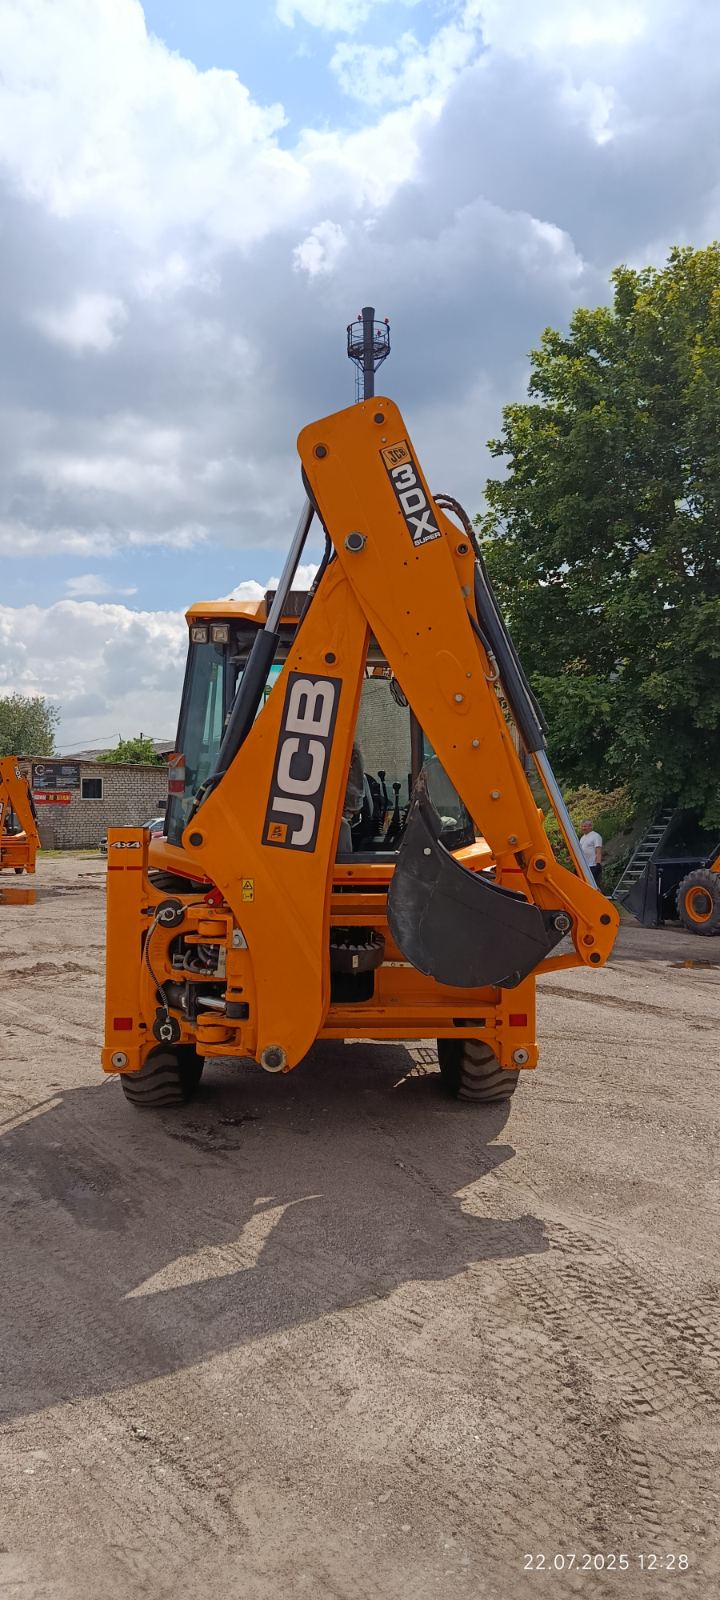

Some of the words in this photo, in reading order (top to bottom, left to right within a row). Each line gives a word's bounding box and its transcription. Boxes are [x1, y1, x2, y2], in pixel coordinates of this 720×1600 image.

[388, 448, 406, 463] JCB
[391, 463, 438, 540] 3DX
[414, 531, 441, 546] SUPER
[272, 679, 335, 846] JCB
